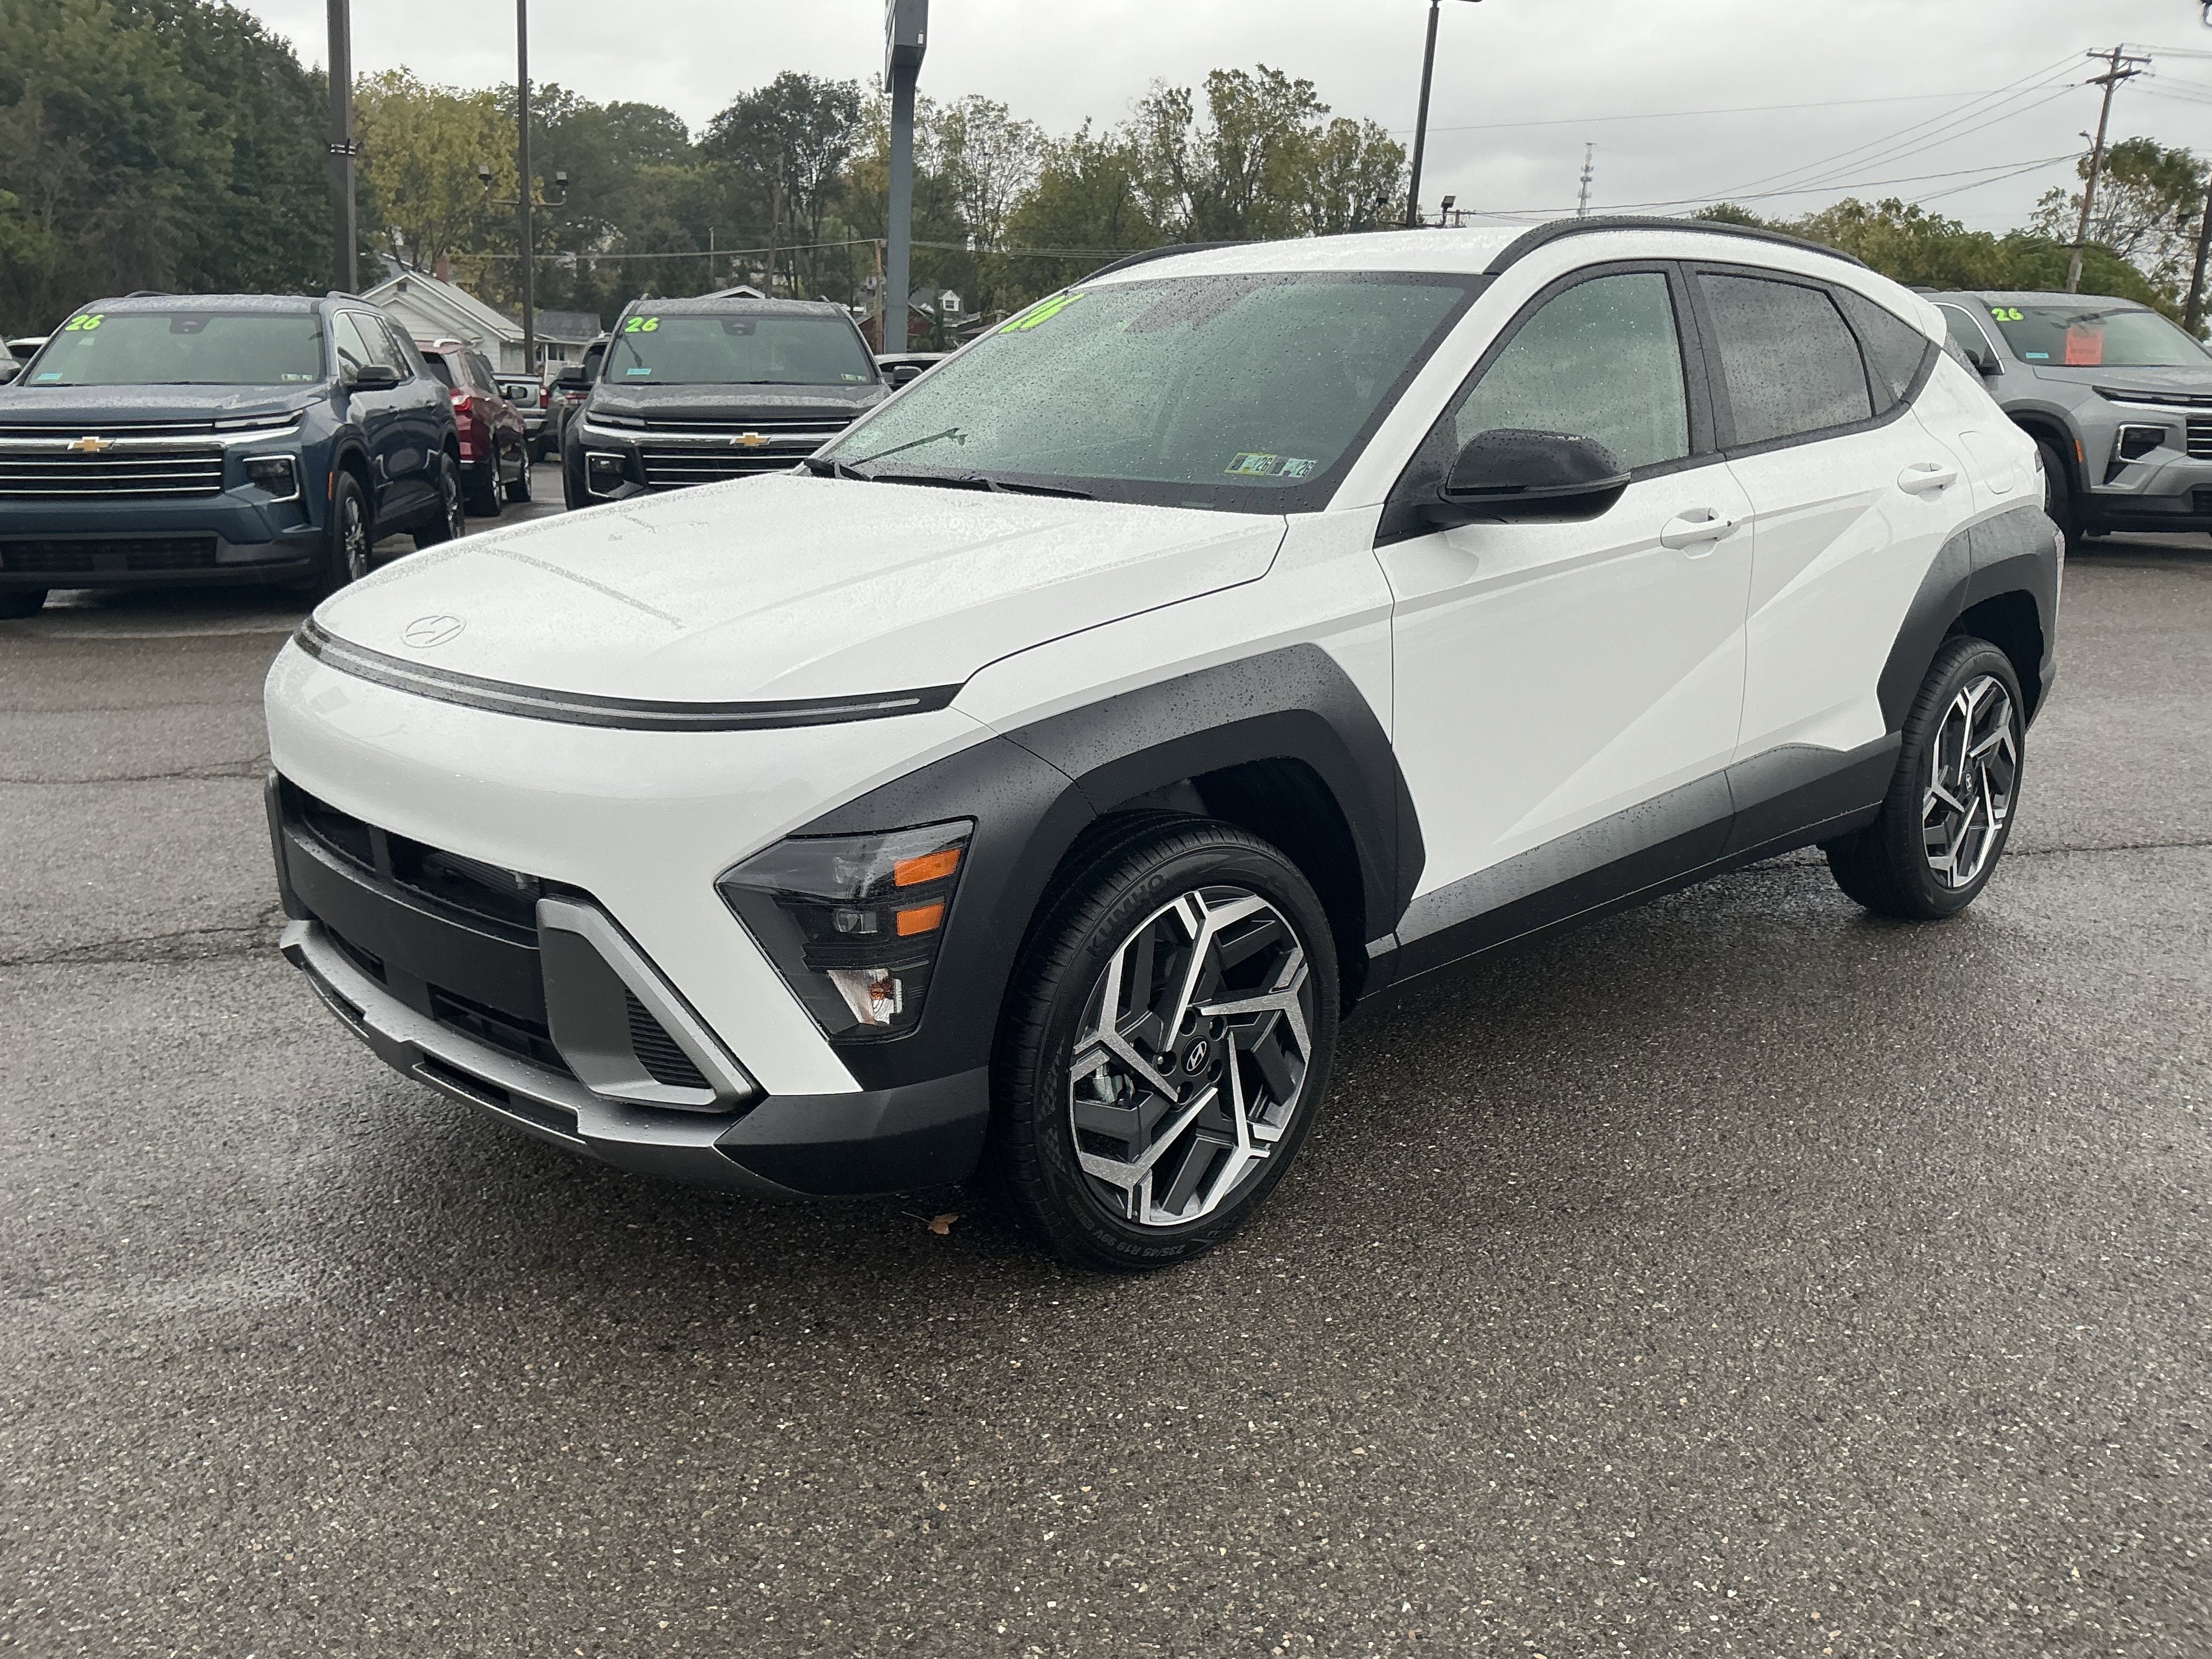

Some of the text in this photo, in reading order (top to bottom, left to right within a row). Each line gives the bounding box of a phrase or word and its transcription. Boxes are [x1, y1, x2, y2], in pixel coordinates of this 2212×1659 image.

[1991, 308, 2024, 321] 26
[65, 315, 105, 331] 26
[624, 317, 659, 332] 26
[1255, 457, 1273, 471] 26
[1086, 874, 1164, 957] KUMHO
